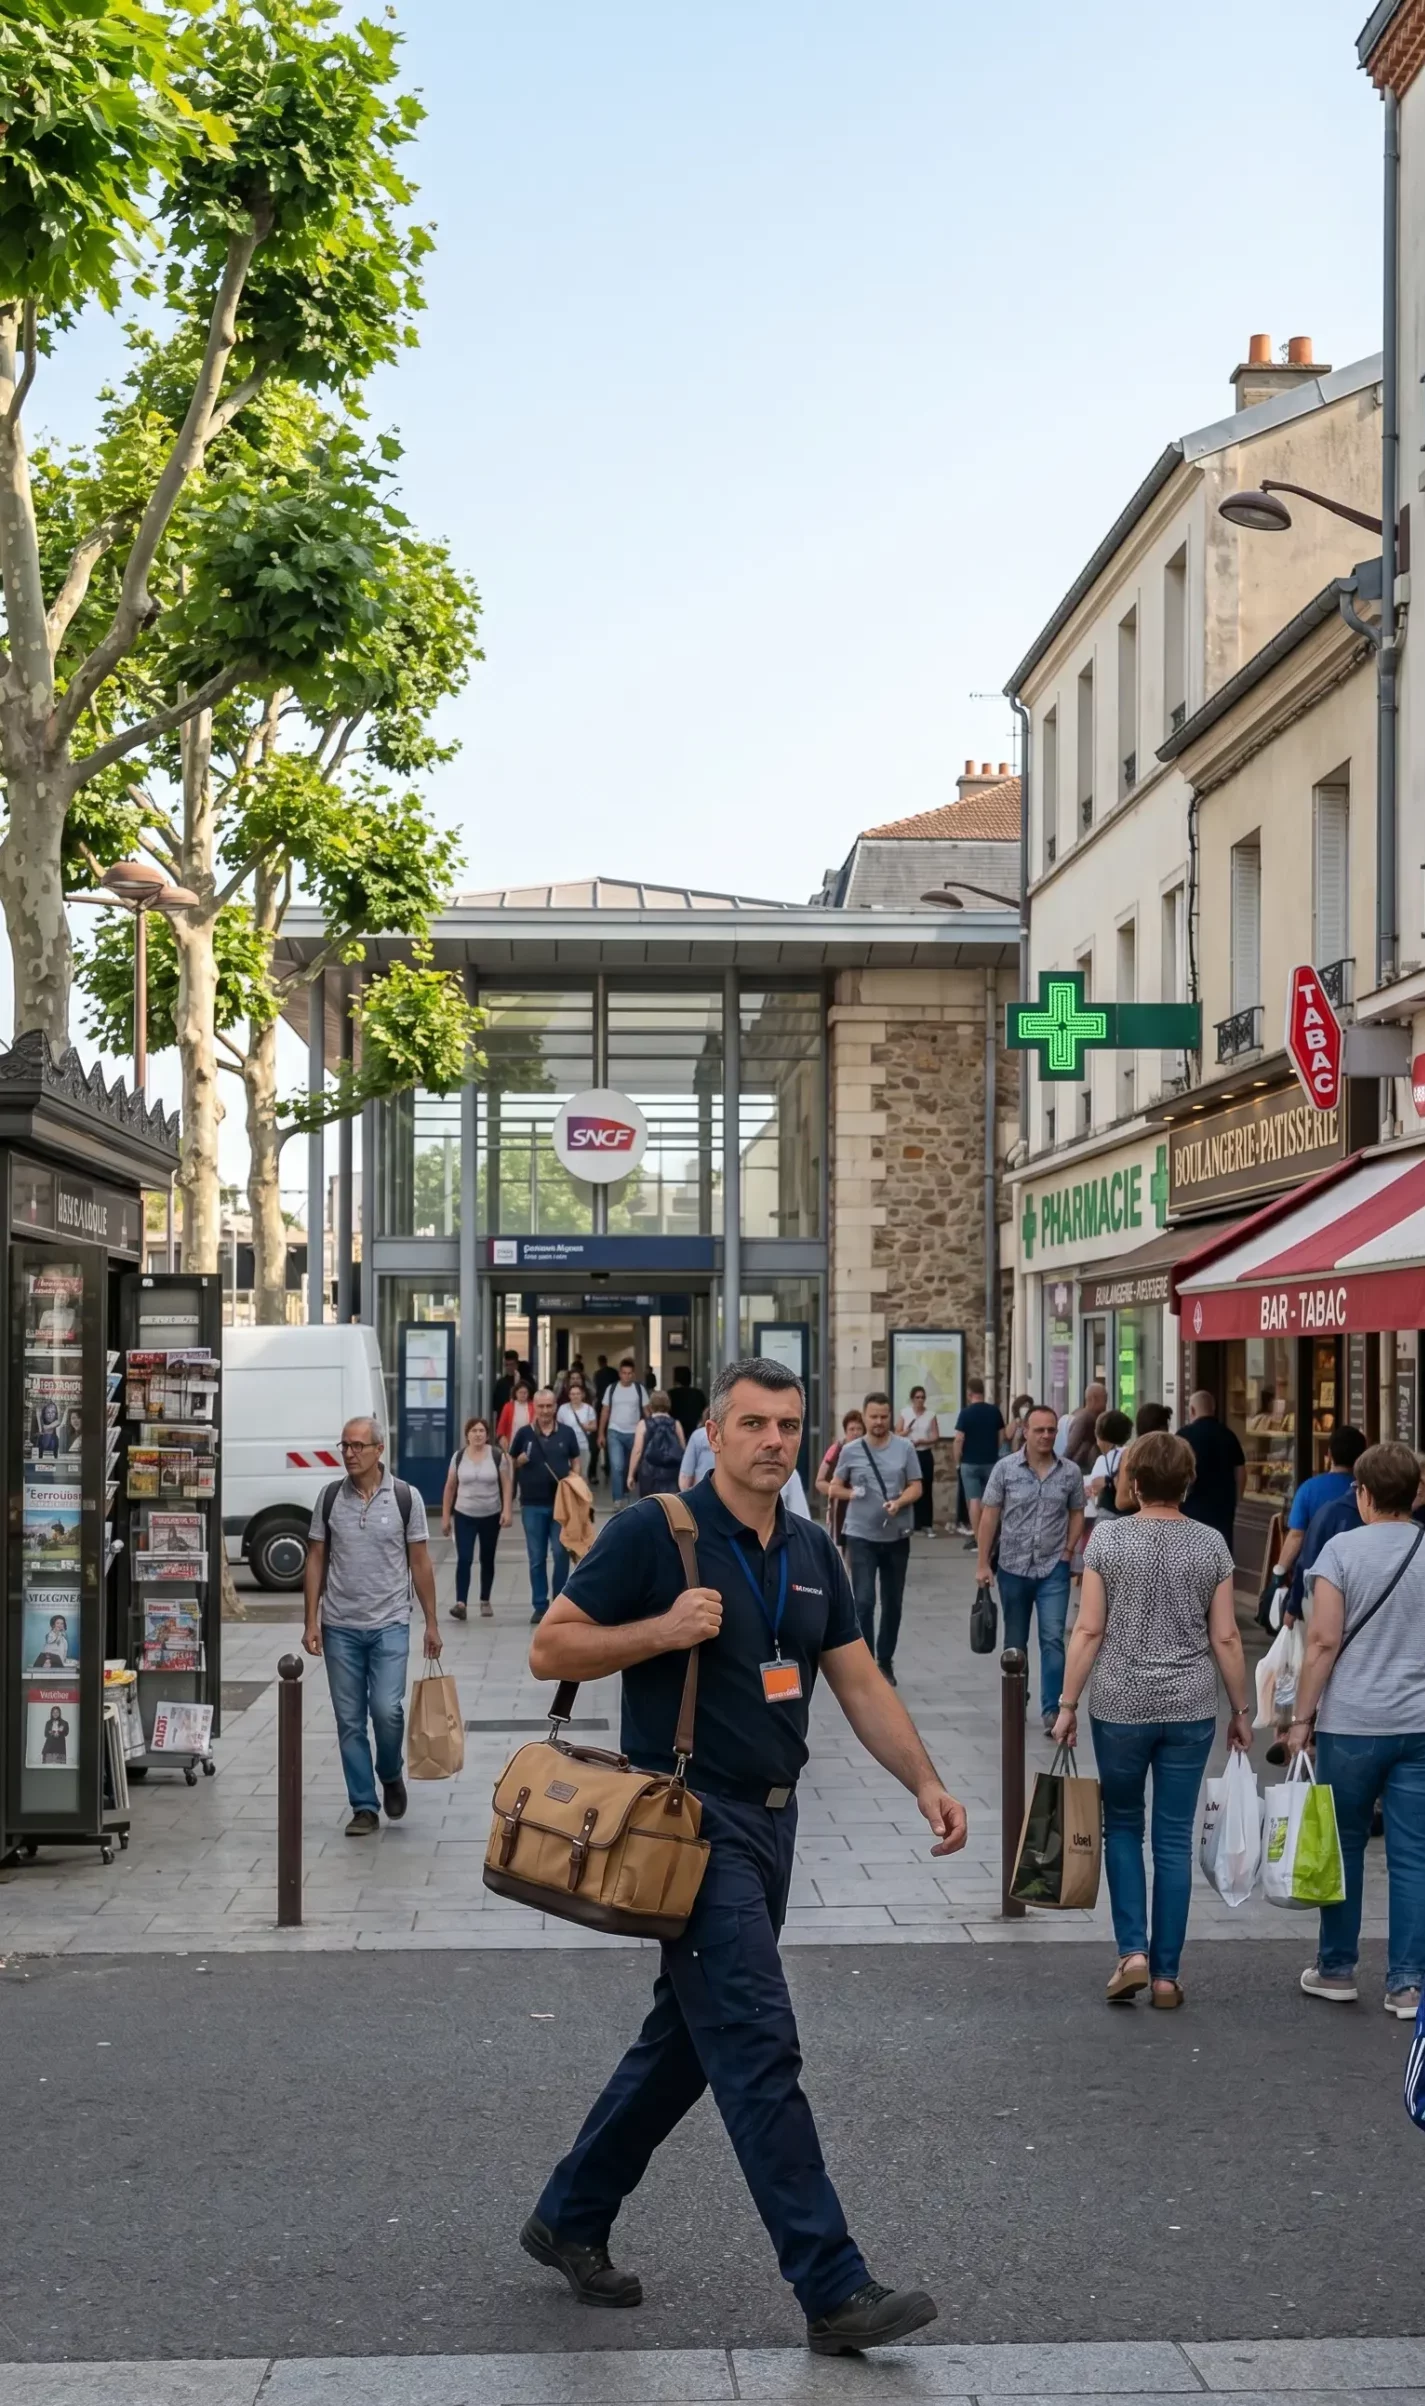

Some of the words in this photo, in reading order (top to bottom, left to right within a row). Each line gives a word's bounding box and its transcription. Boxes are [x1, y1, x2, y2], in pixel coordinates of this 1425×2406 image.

[1299, 984, 1334, 1093] TABAC
[570, 1129, 630, 1146] SNCF
[1042, 1164, 1142, 1248] PHARMACIE
[1260, 1296, 1288, 1330] BAR
[1299, 1287, 1347, 1328] TABAC
